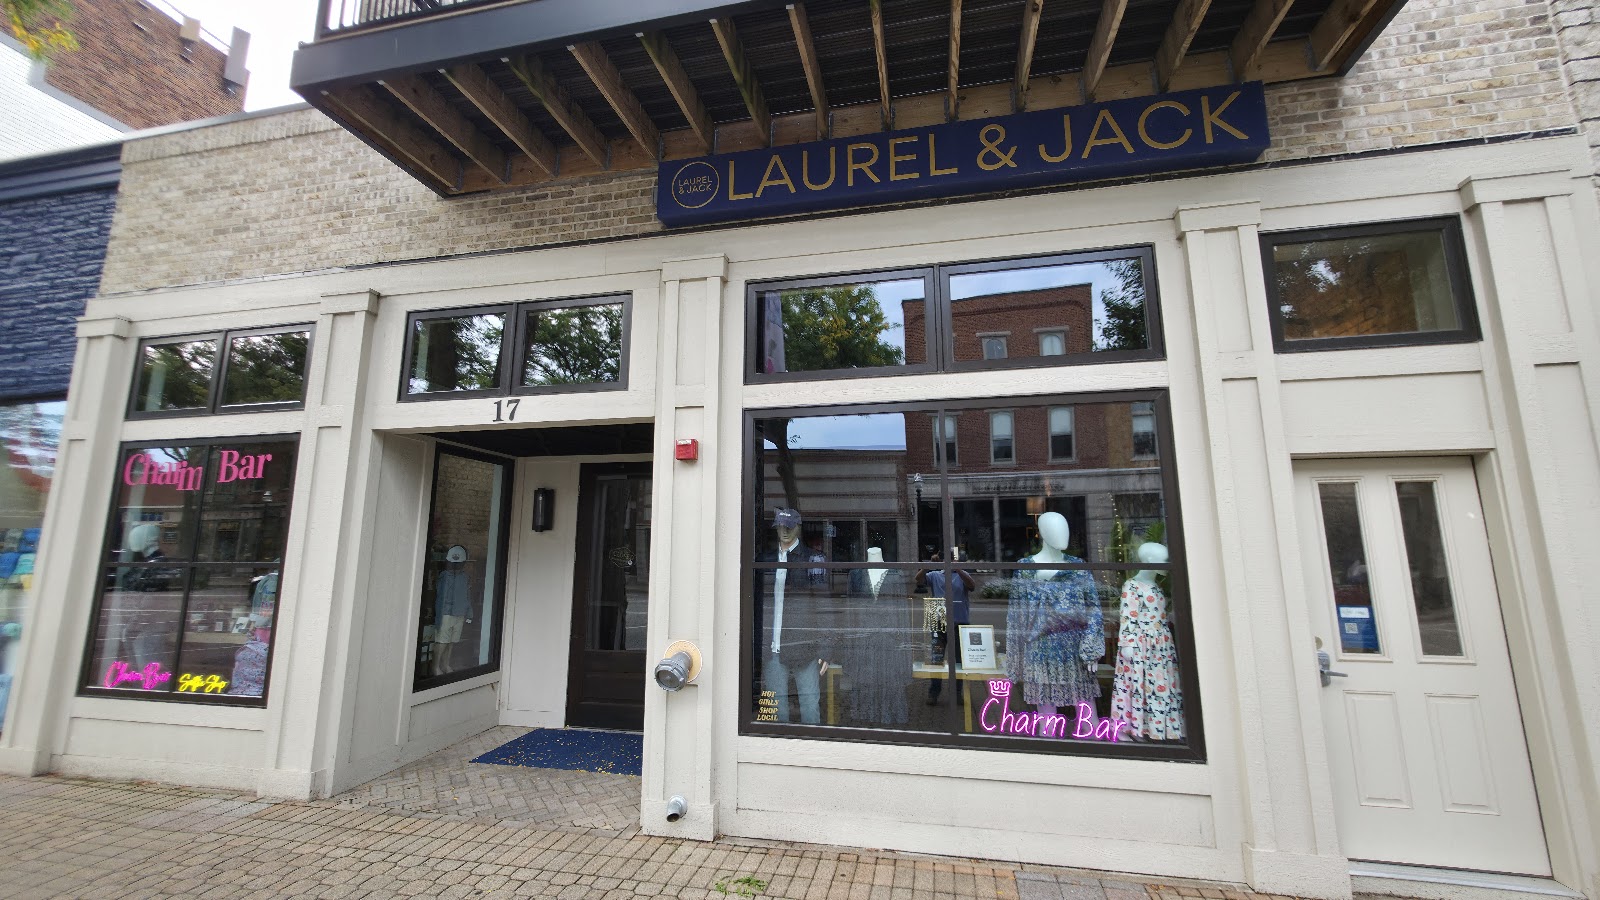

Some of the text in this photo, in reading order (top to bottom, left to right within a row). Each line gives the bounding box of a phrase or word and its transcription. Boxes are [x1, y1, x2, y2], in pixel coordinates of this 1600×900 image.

[728, 90, 1249, 201] LAUREL & JACK
[678, 176, 713, 186] LAUREL
[678, 184, 712, 194] & JACK
[492, 399, 521, 422] 17
[124, 450, 273, 491] Charm Bar
[981, 696, 1127, 743] Charm Bar
